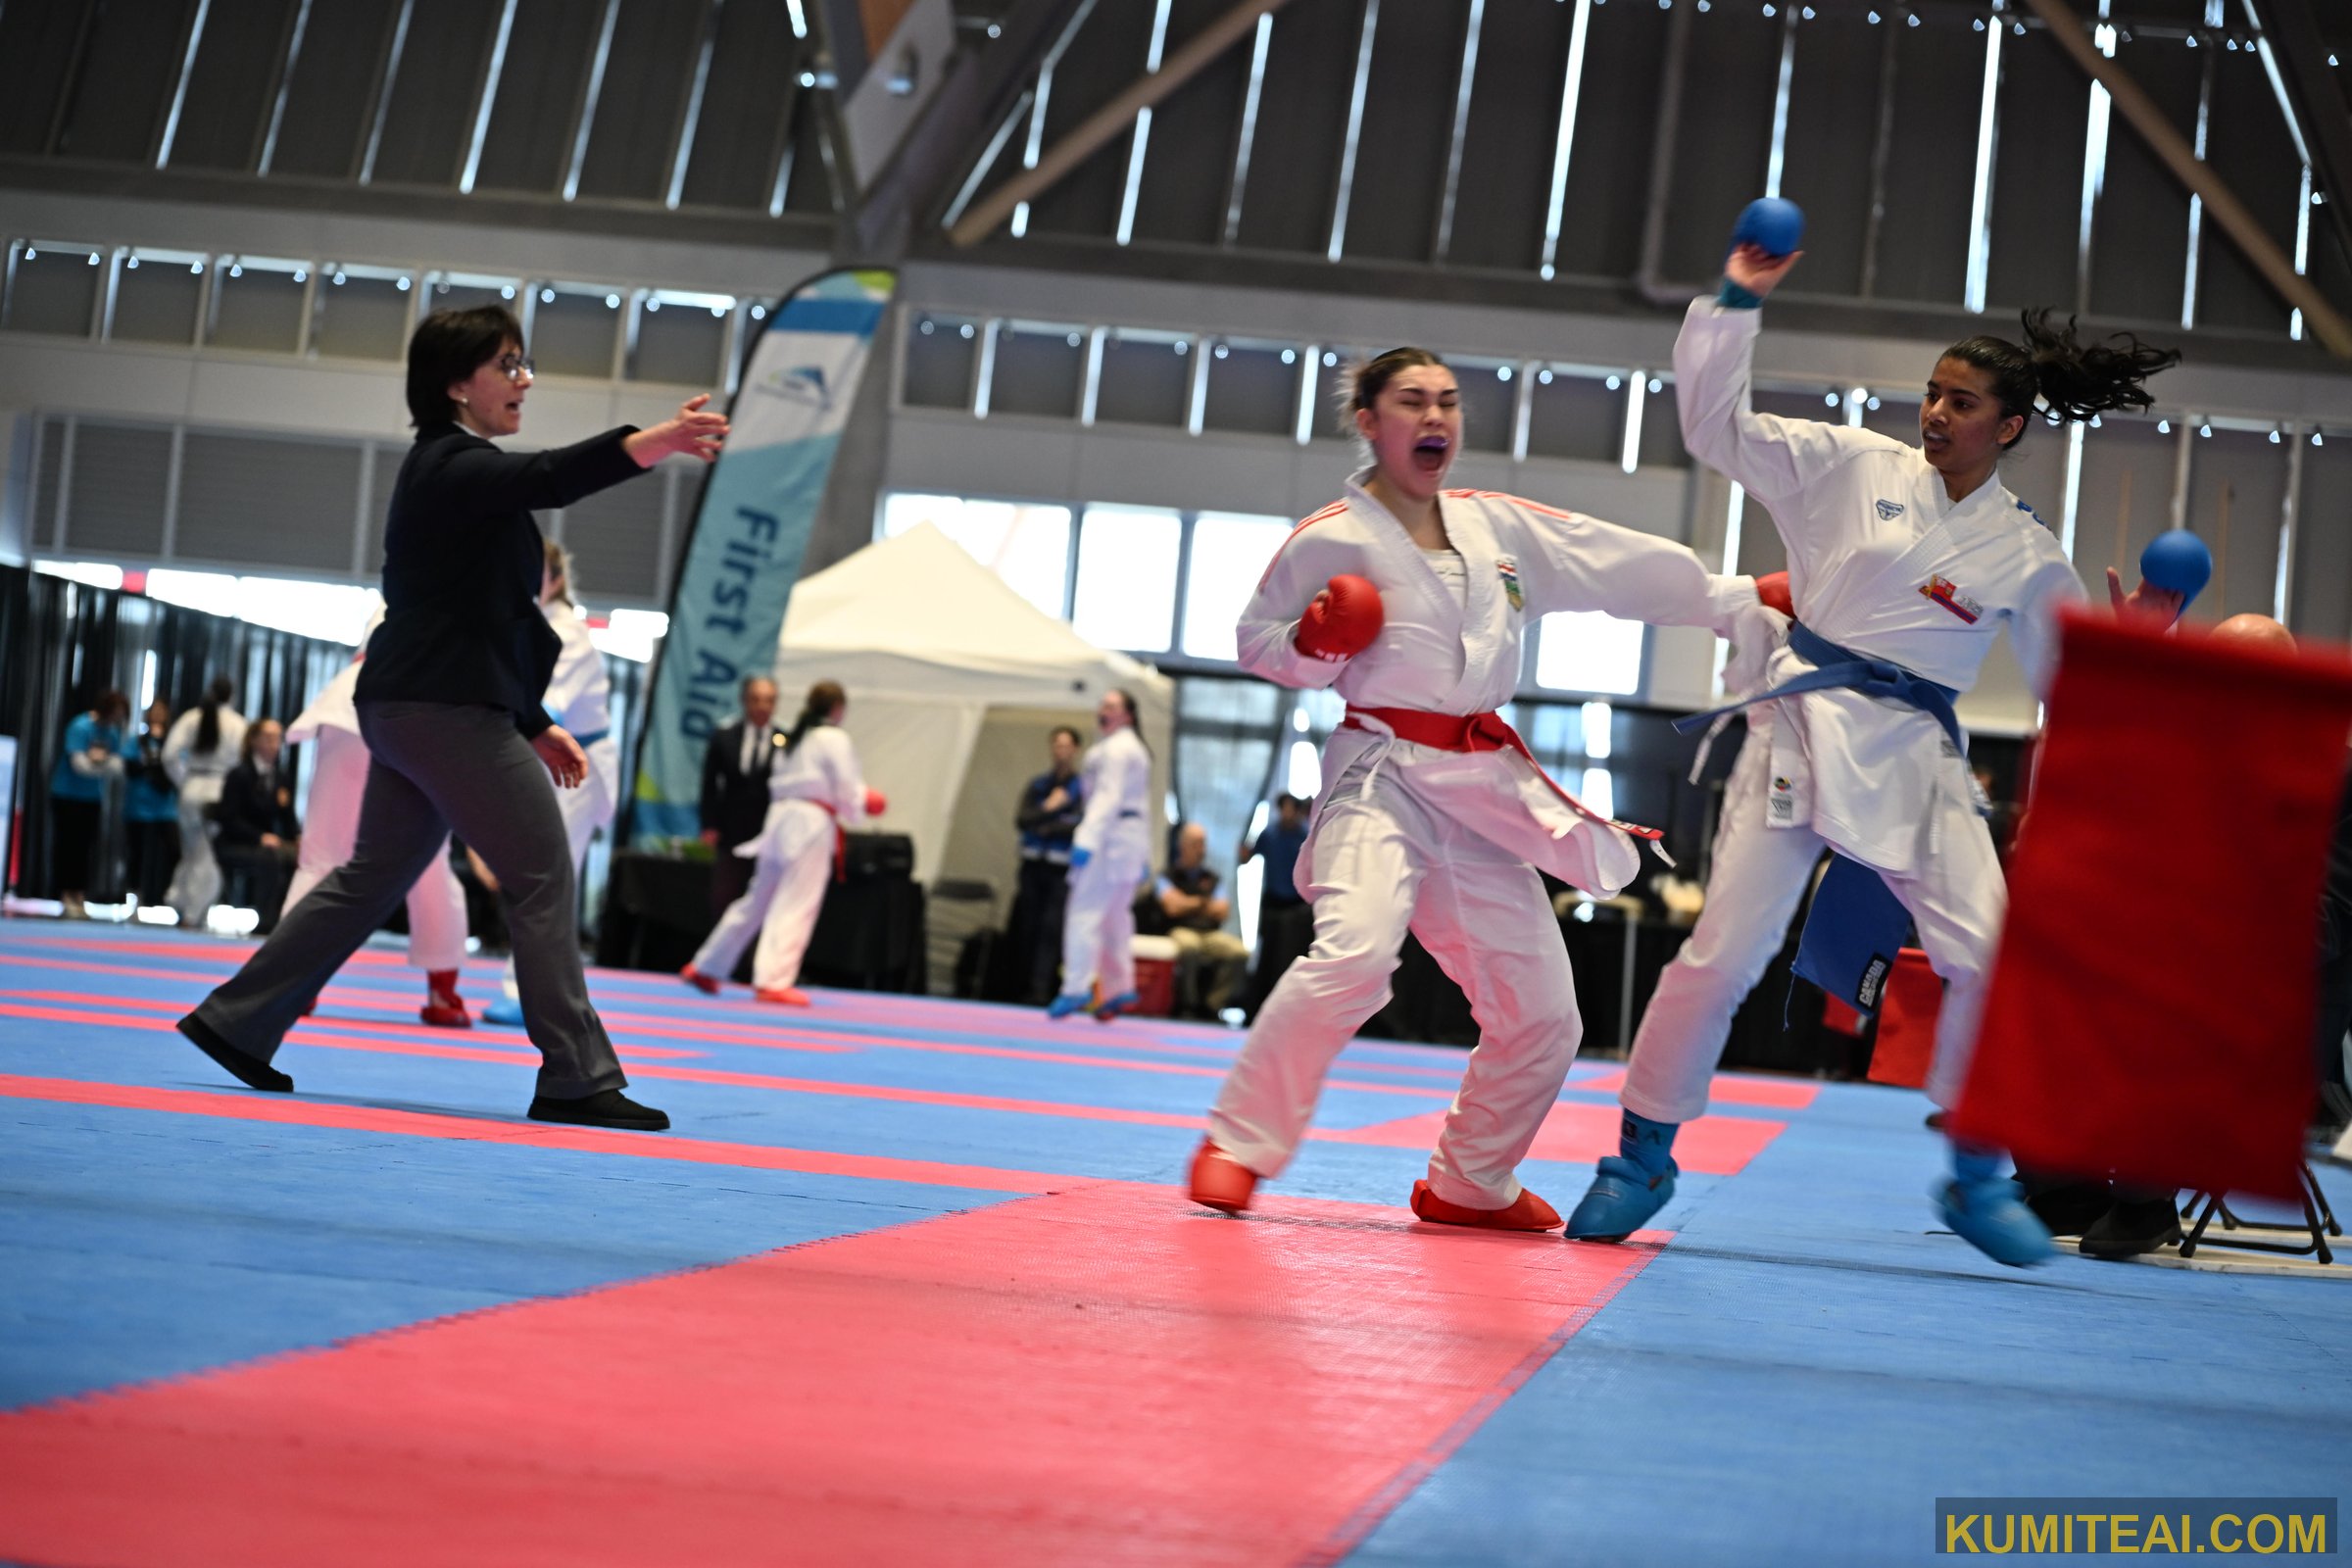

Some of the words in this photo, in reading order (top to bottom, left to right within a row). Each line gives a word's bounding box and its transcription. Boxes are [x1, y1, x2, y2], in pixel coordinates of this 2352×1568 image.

[705, 505, 780, 635] First
[680, 648, 739, 740] Aid
[1858, 959, 1885, 1004] CANADA
